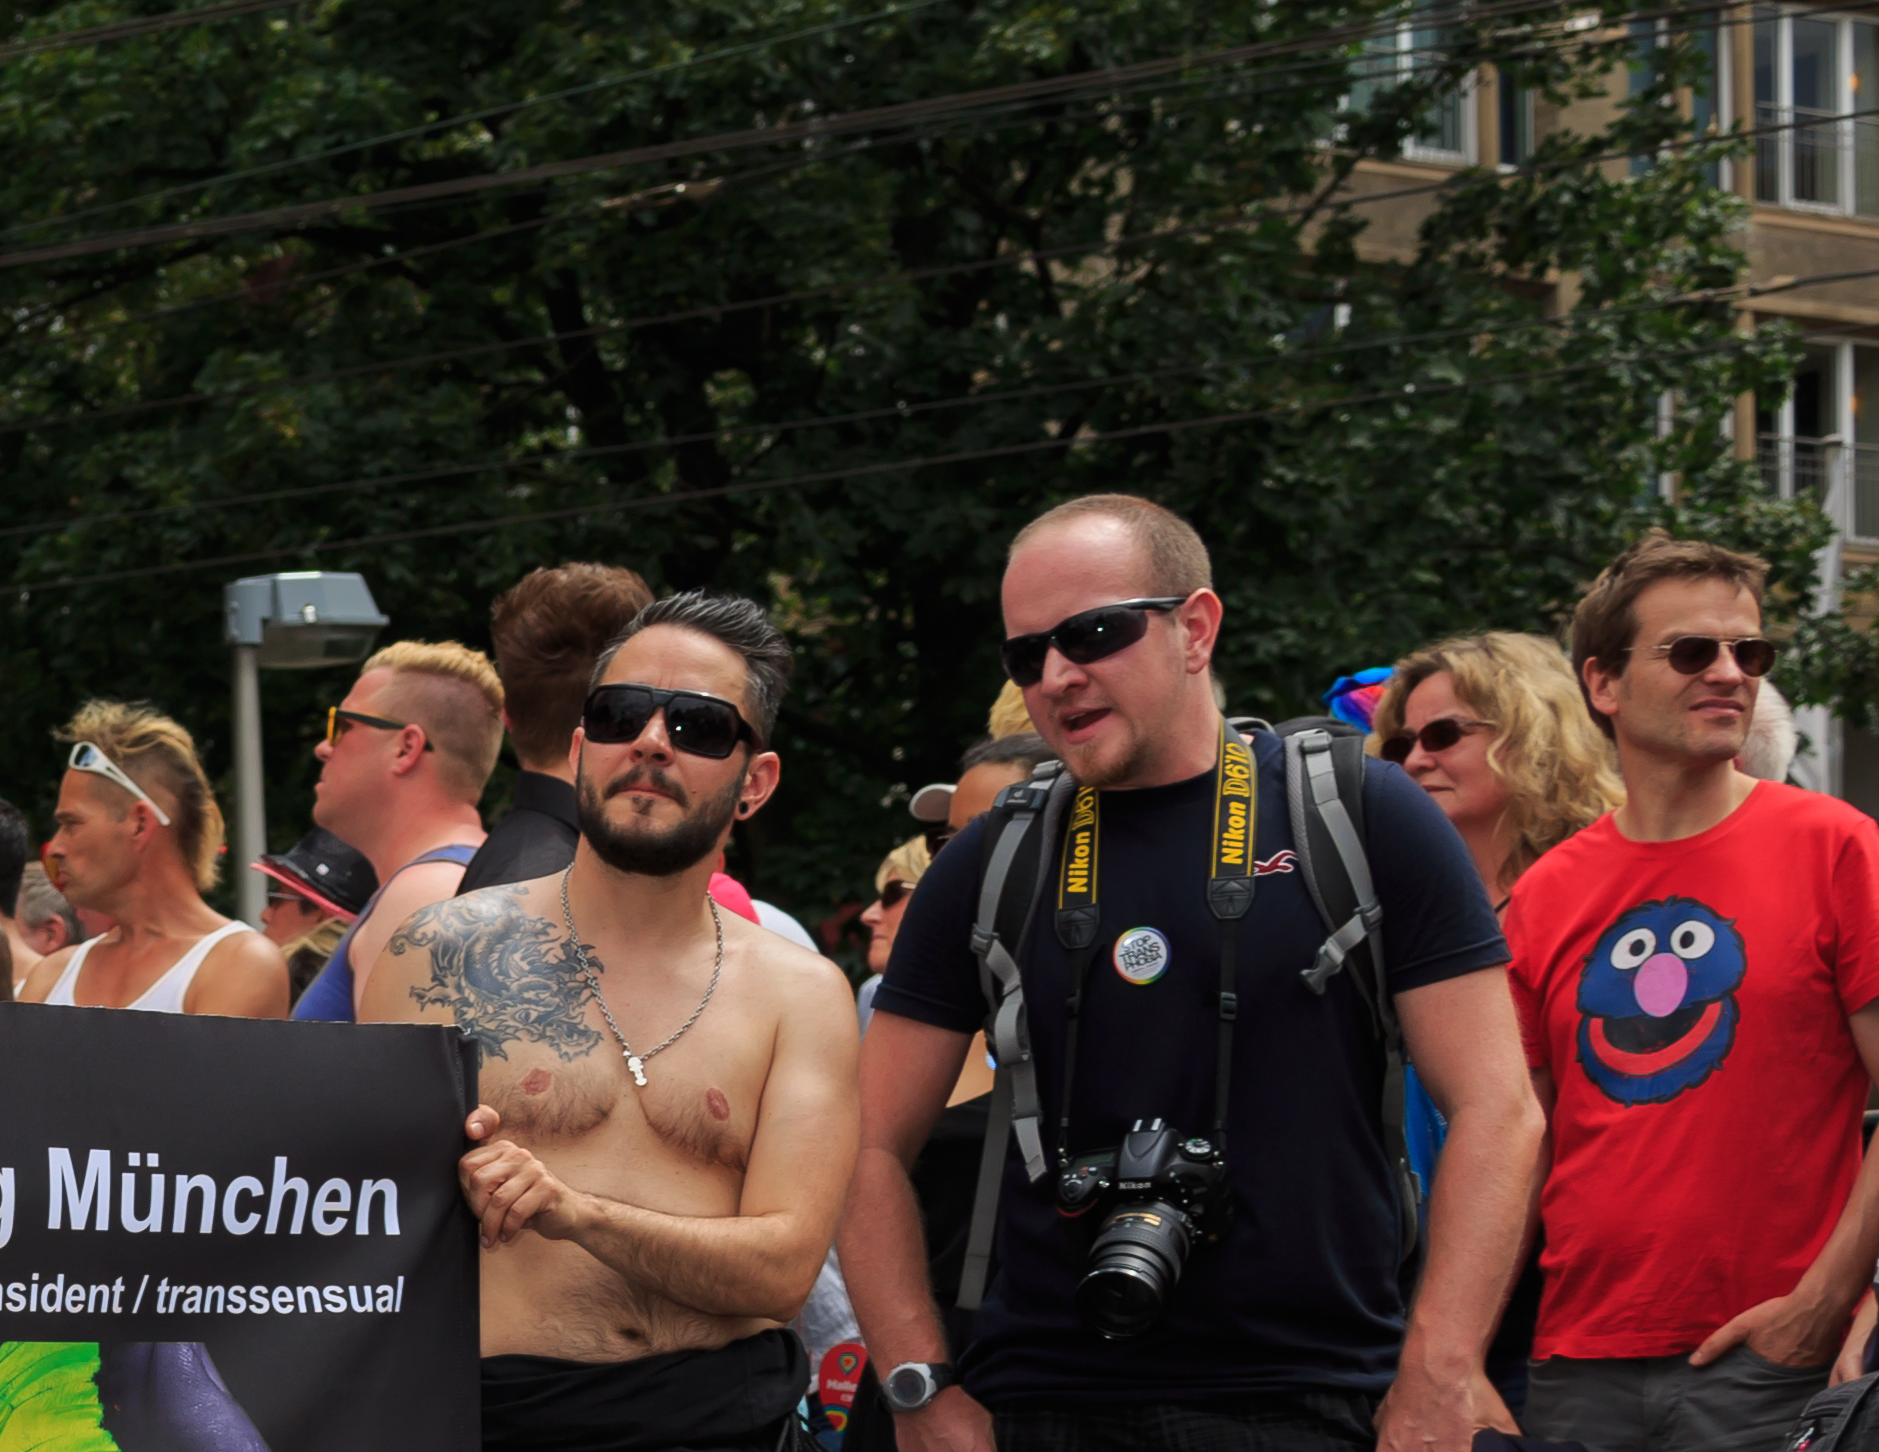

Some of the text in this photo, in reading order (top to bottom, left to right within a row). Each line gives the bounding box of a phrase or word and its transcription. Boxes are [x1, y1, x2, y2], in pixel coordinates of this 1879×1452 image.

[1067, 832, 1091, 892] Nikon
[1221, 802, 1247, 864] Nikon
[48, 1147, 400, 1235] München
[1119, 1182, 1151, 1190] Nikon
[157, 1276, 404, 1314] transsensual
